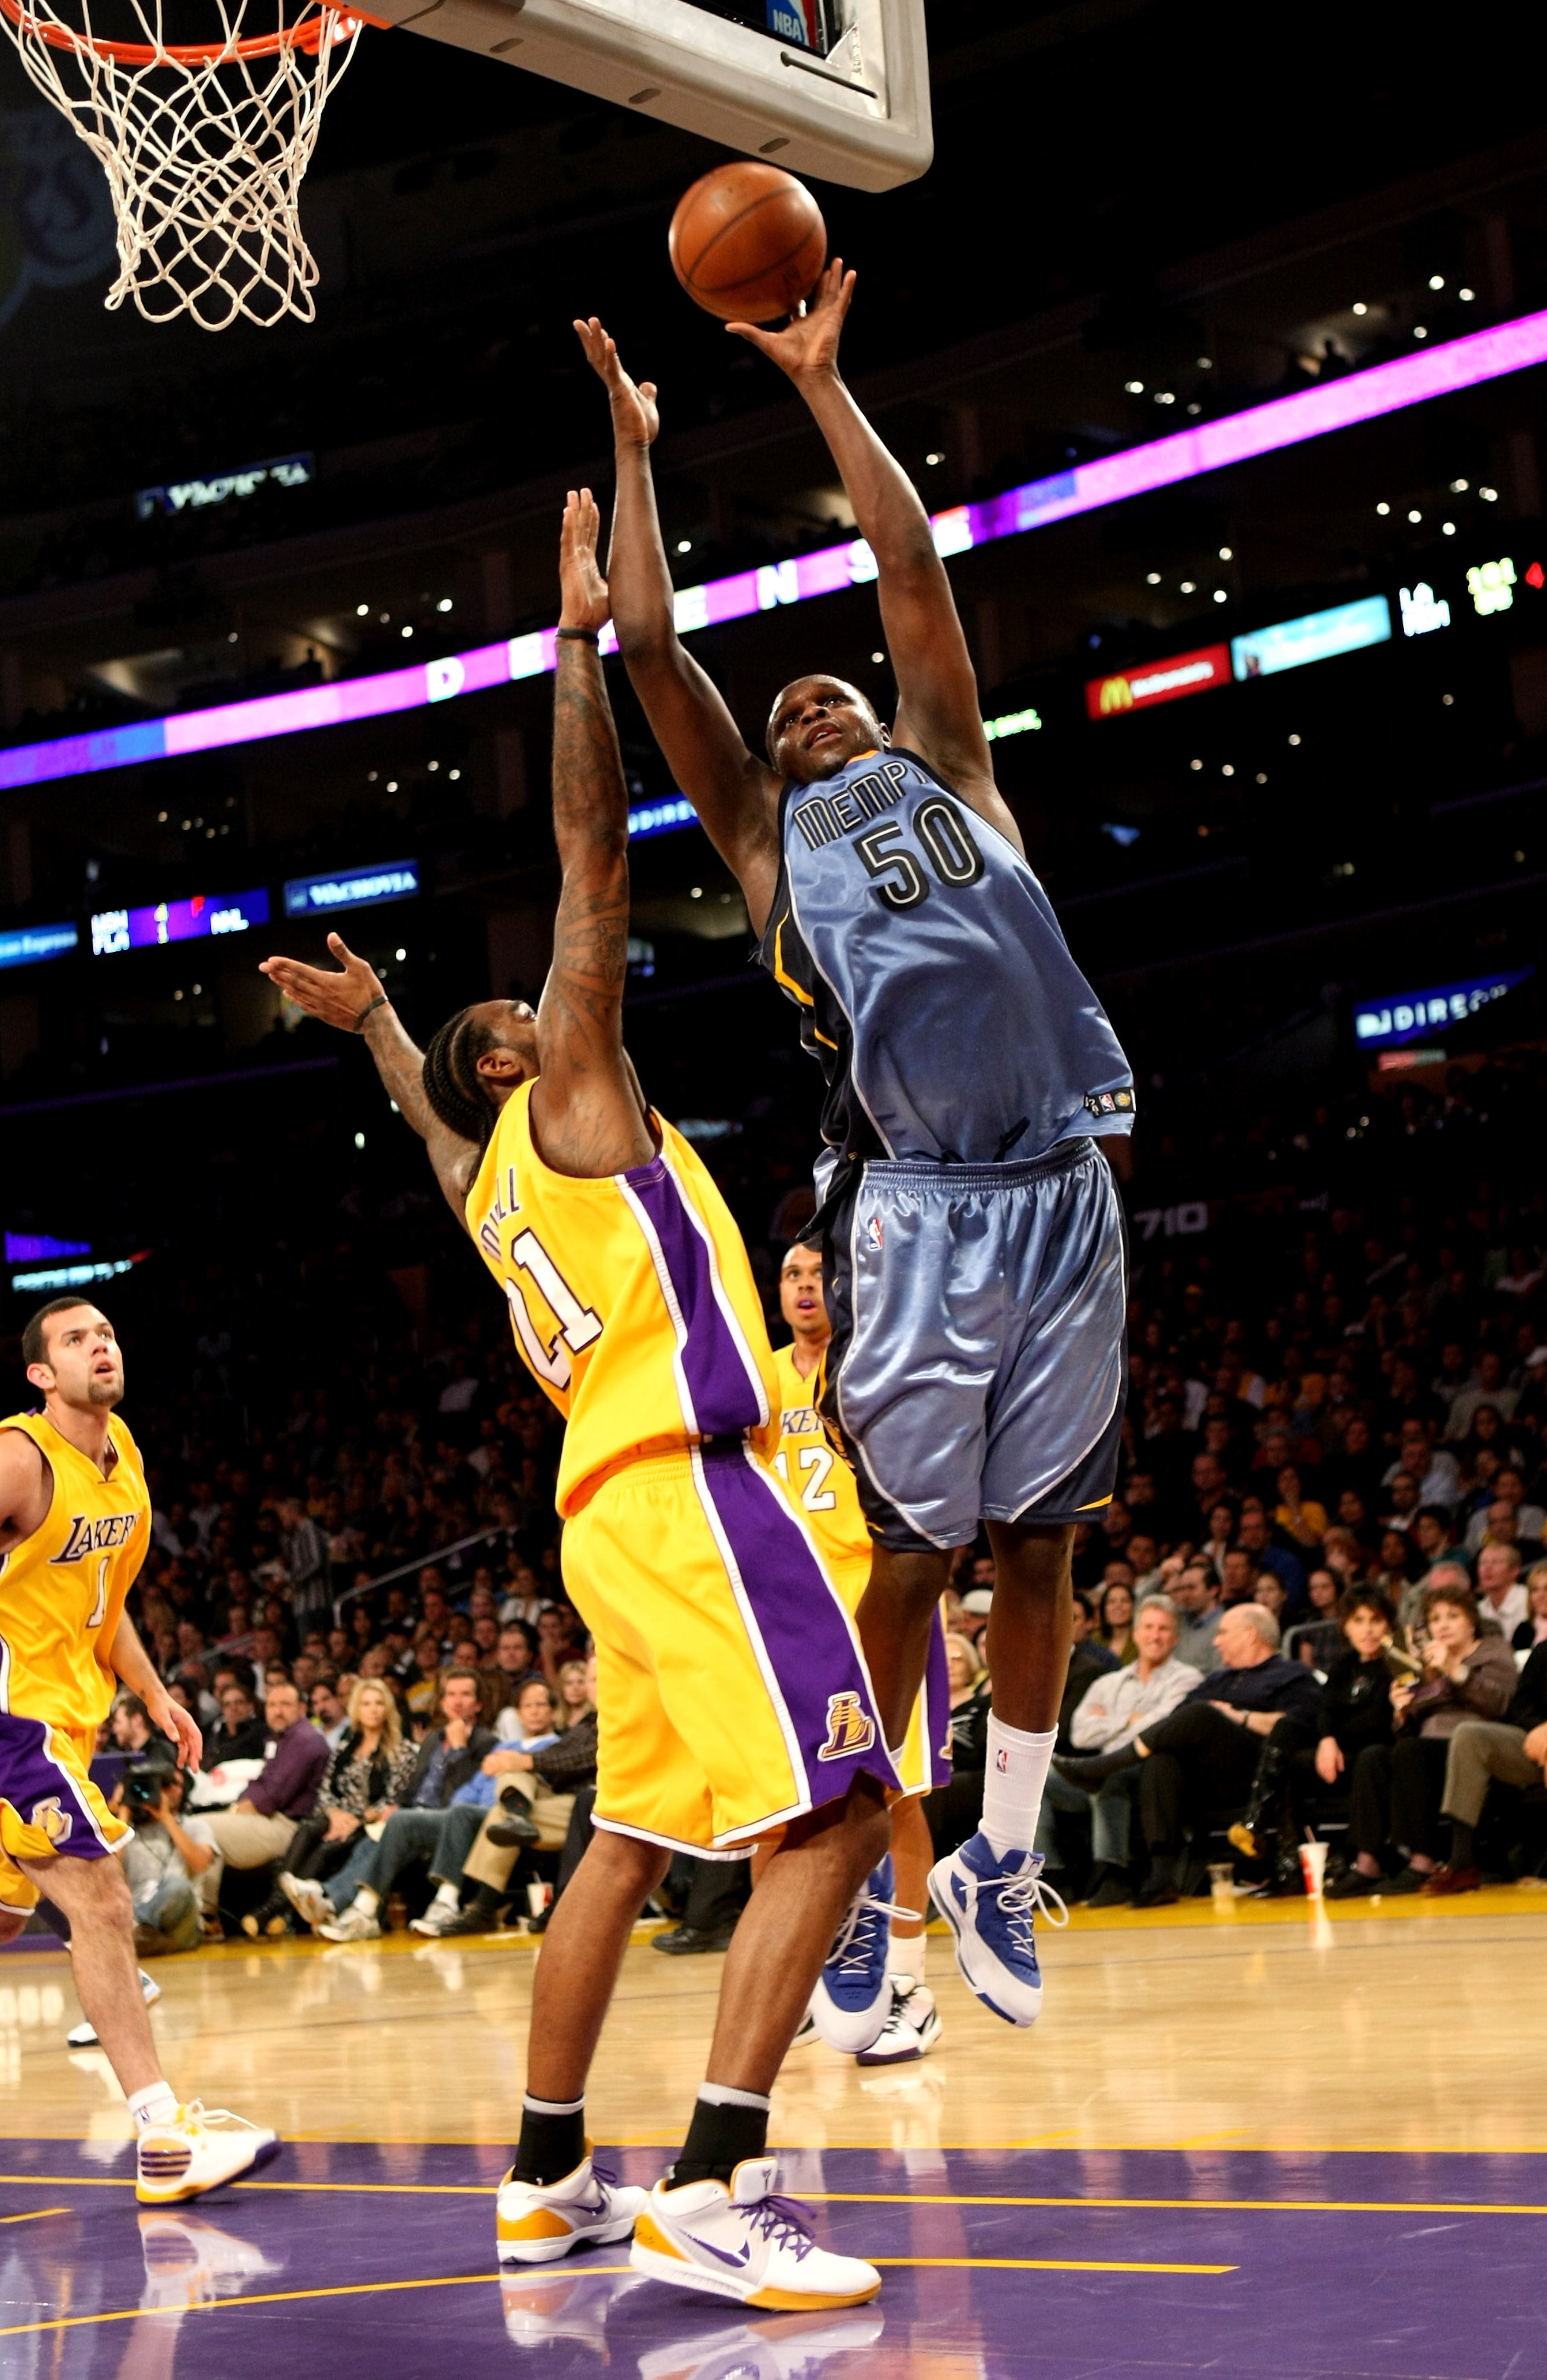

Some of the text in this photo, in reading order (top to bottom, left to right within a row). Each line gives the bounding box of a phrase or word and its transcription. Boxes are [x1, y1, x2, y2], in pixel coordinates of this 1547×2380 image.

[772, 9, 803, 40] NBA
[852, 796, 985, 912] 50
[309, 871, 417, 906] WACHOVIA
[1133, 1201, 1208, 1240] 710
[48, 1514, 140, 1564] LAKER
